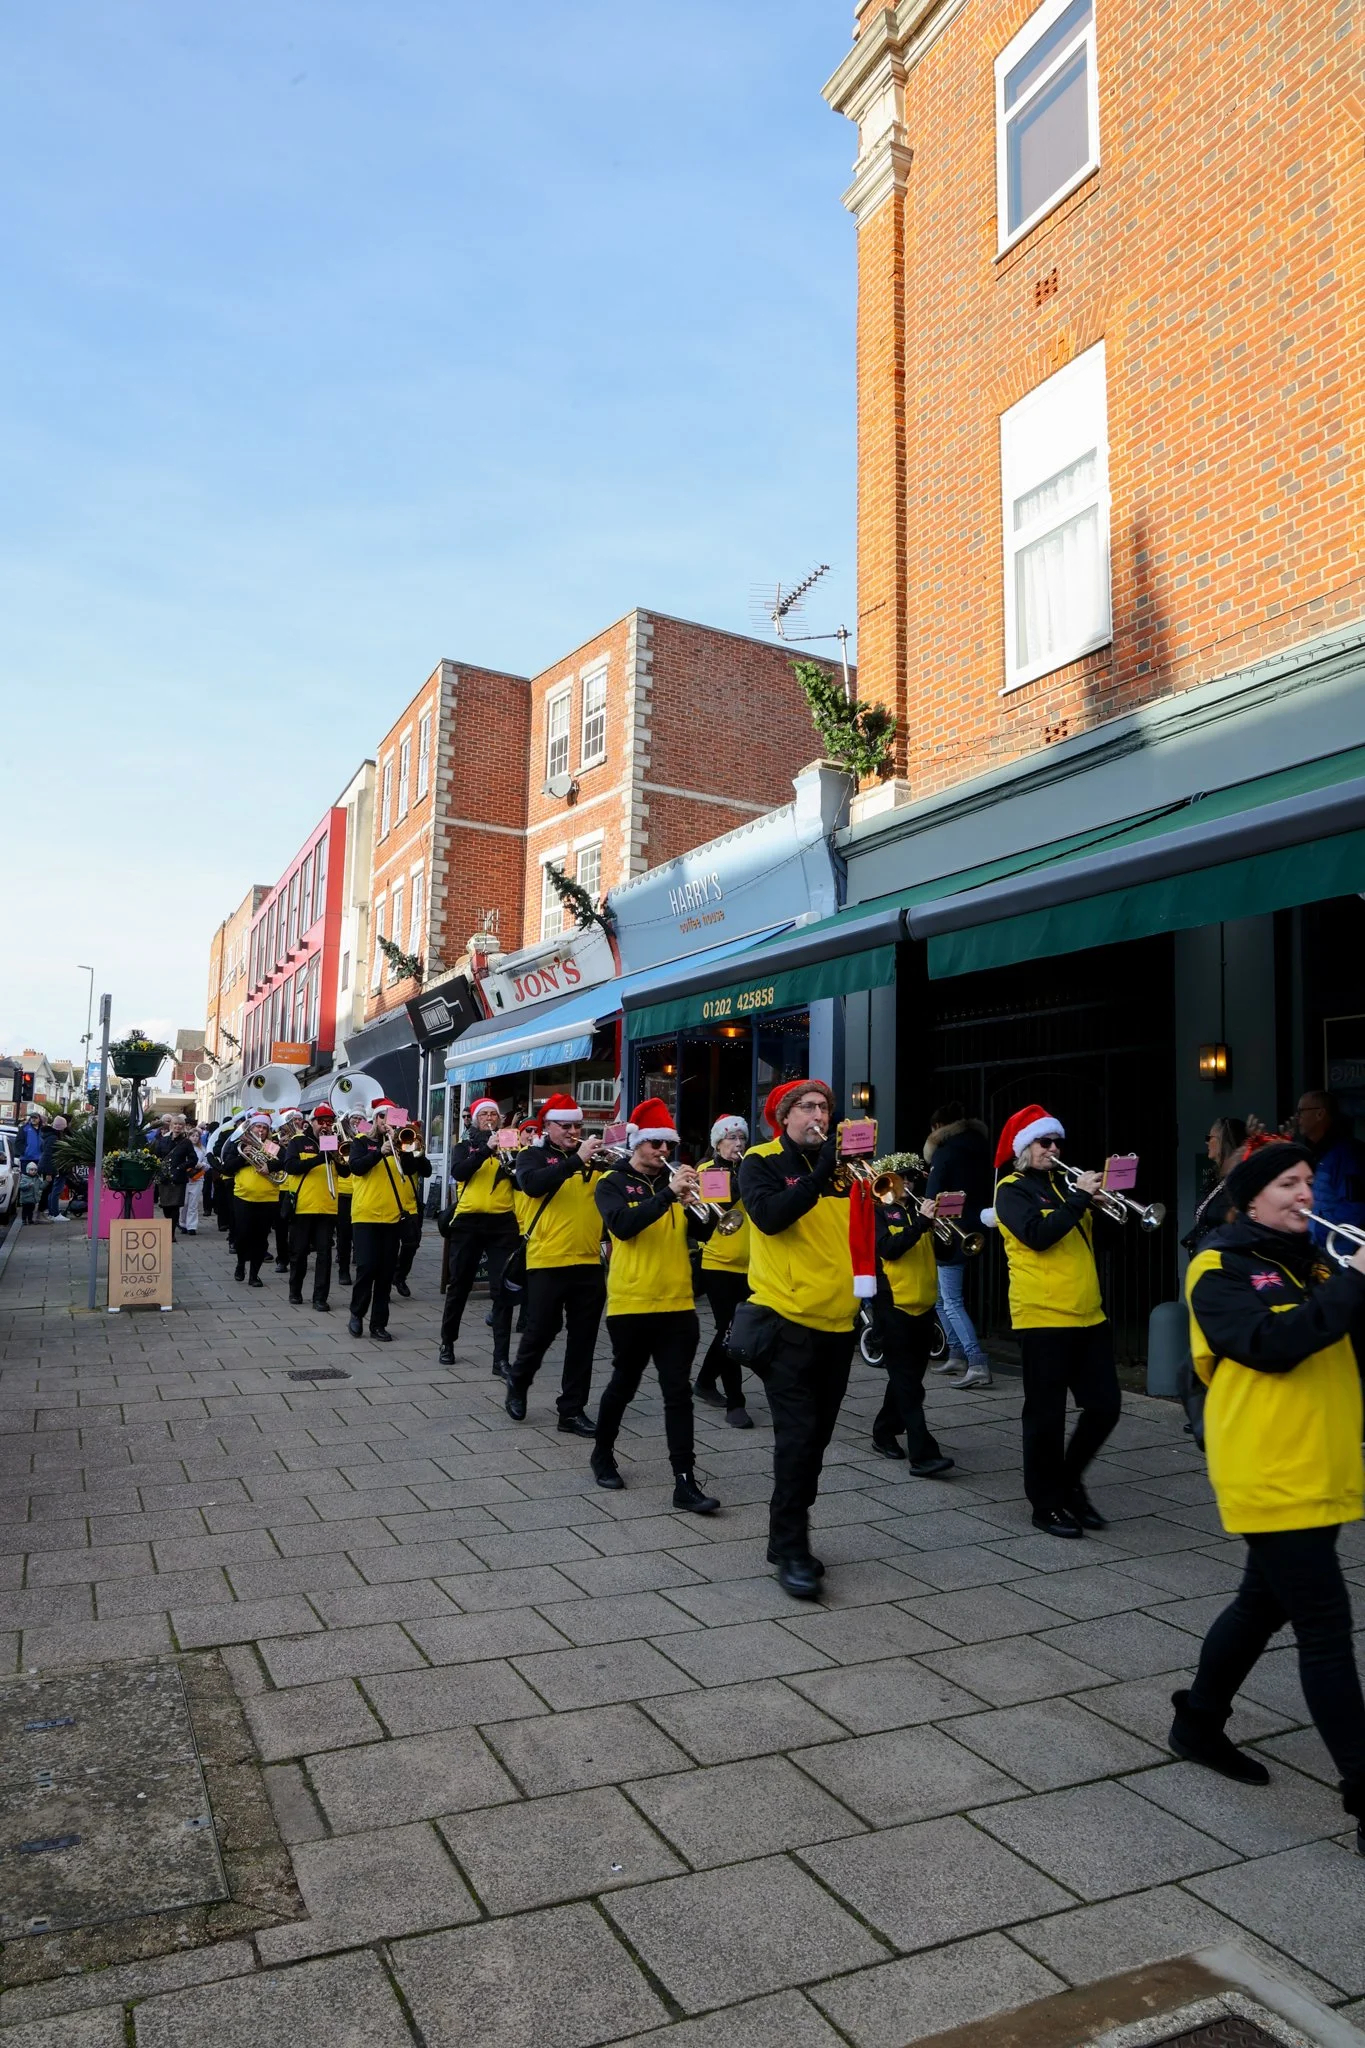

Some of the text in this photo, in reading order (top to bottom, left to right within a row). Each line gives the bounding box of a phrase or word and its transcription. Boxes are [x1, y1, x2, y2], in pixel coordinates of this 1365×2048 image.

[668, 872, 723, 917] HARRY'S
[679, 909, 725, 934] coffee house
[513, 956, 581, 1002] JON'S
[703, 986, 774, 1019] 01202 425858
[125, 1231, 157, 1250] BO
[125, 1253, 157, 1272] MO
[121, 1275, 160, 1285] ROAST
[136, 1287, 157, 1298] Coffee
